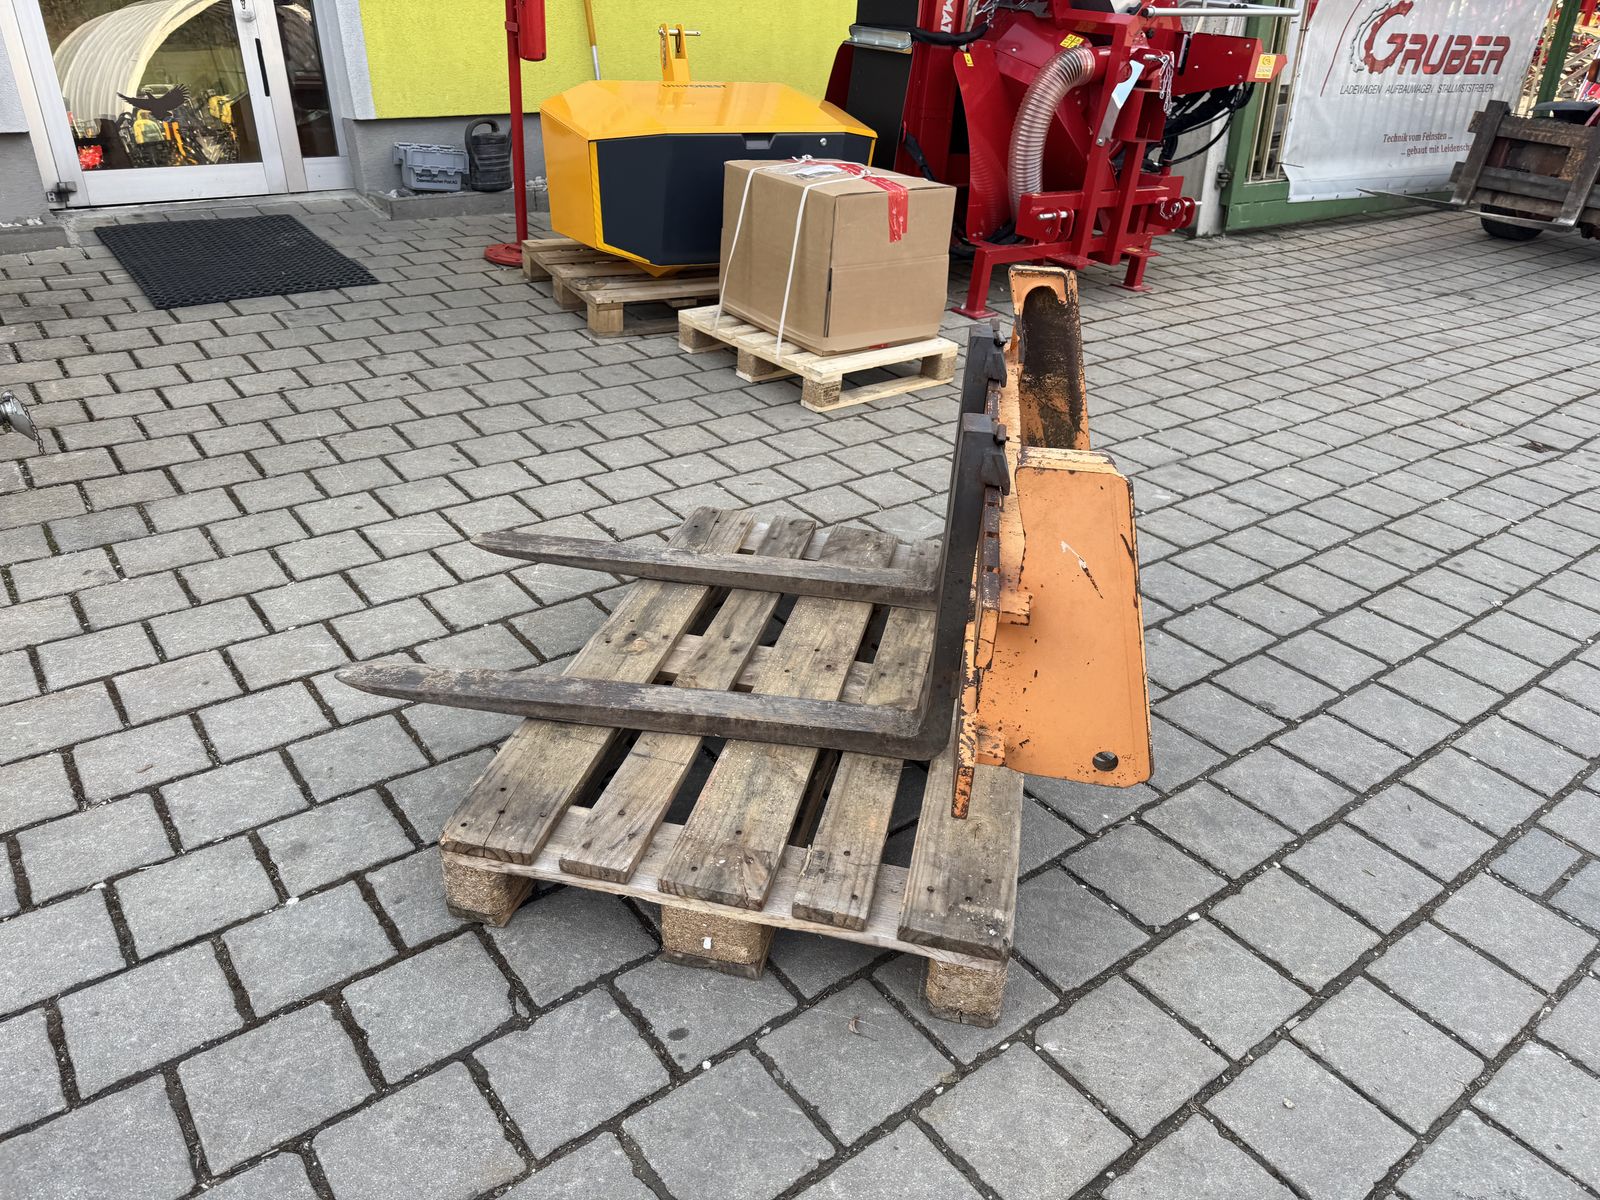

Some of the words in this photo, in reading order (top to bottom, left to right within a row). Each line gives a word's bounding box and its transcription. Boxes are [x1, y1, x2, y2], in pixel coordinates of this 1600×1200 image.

[1364, 0, 1511, 75] GRUBER
[1340, 84, 1382, 95] LADEWAGEN
[1386, 84, 1433, 94] AUFBAUWAGEN
[1383, 133, 1408, 143] Technik
[1422, 132, 1447, 141] Feinsten
[1407, 146, 1428, 157] gebaut
[1429, 145, 1440, 153] mit
